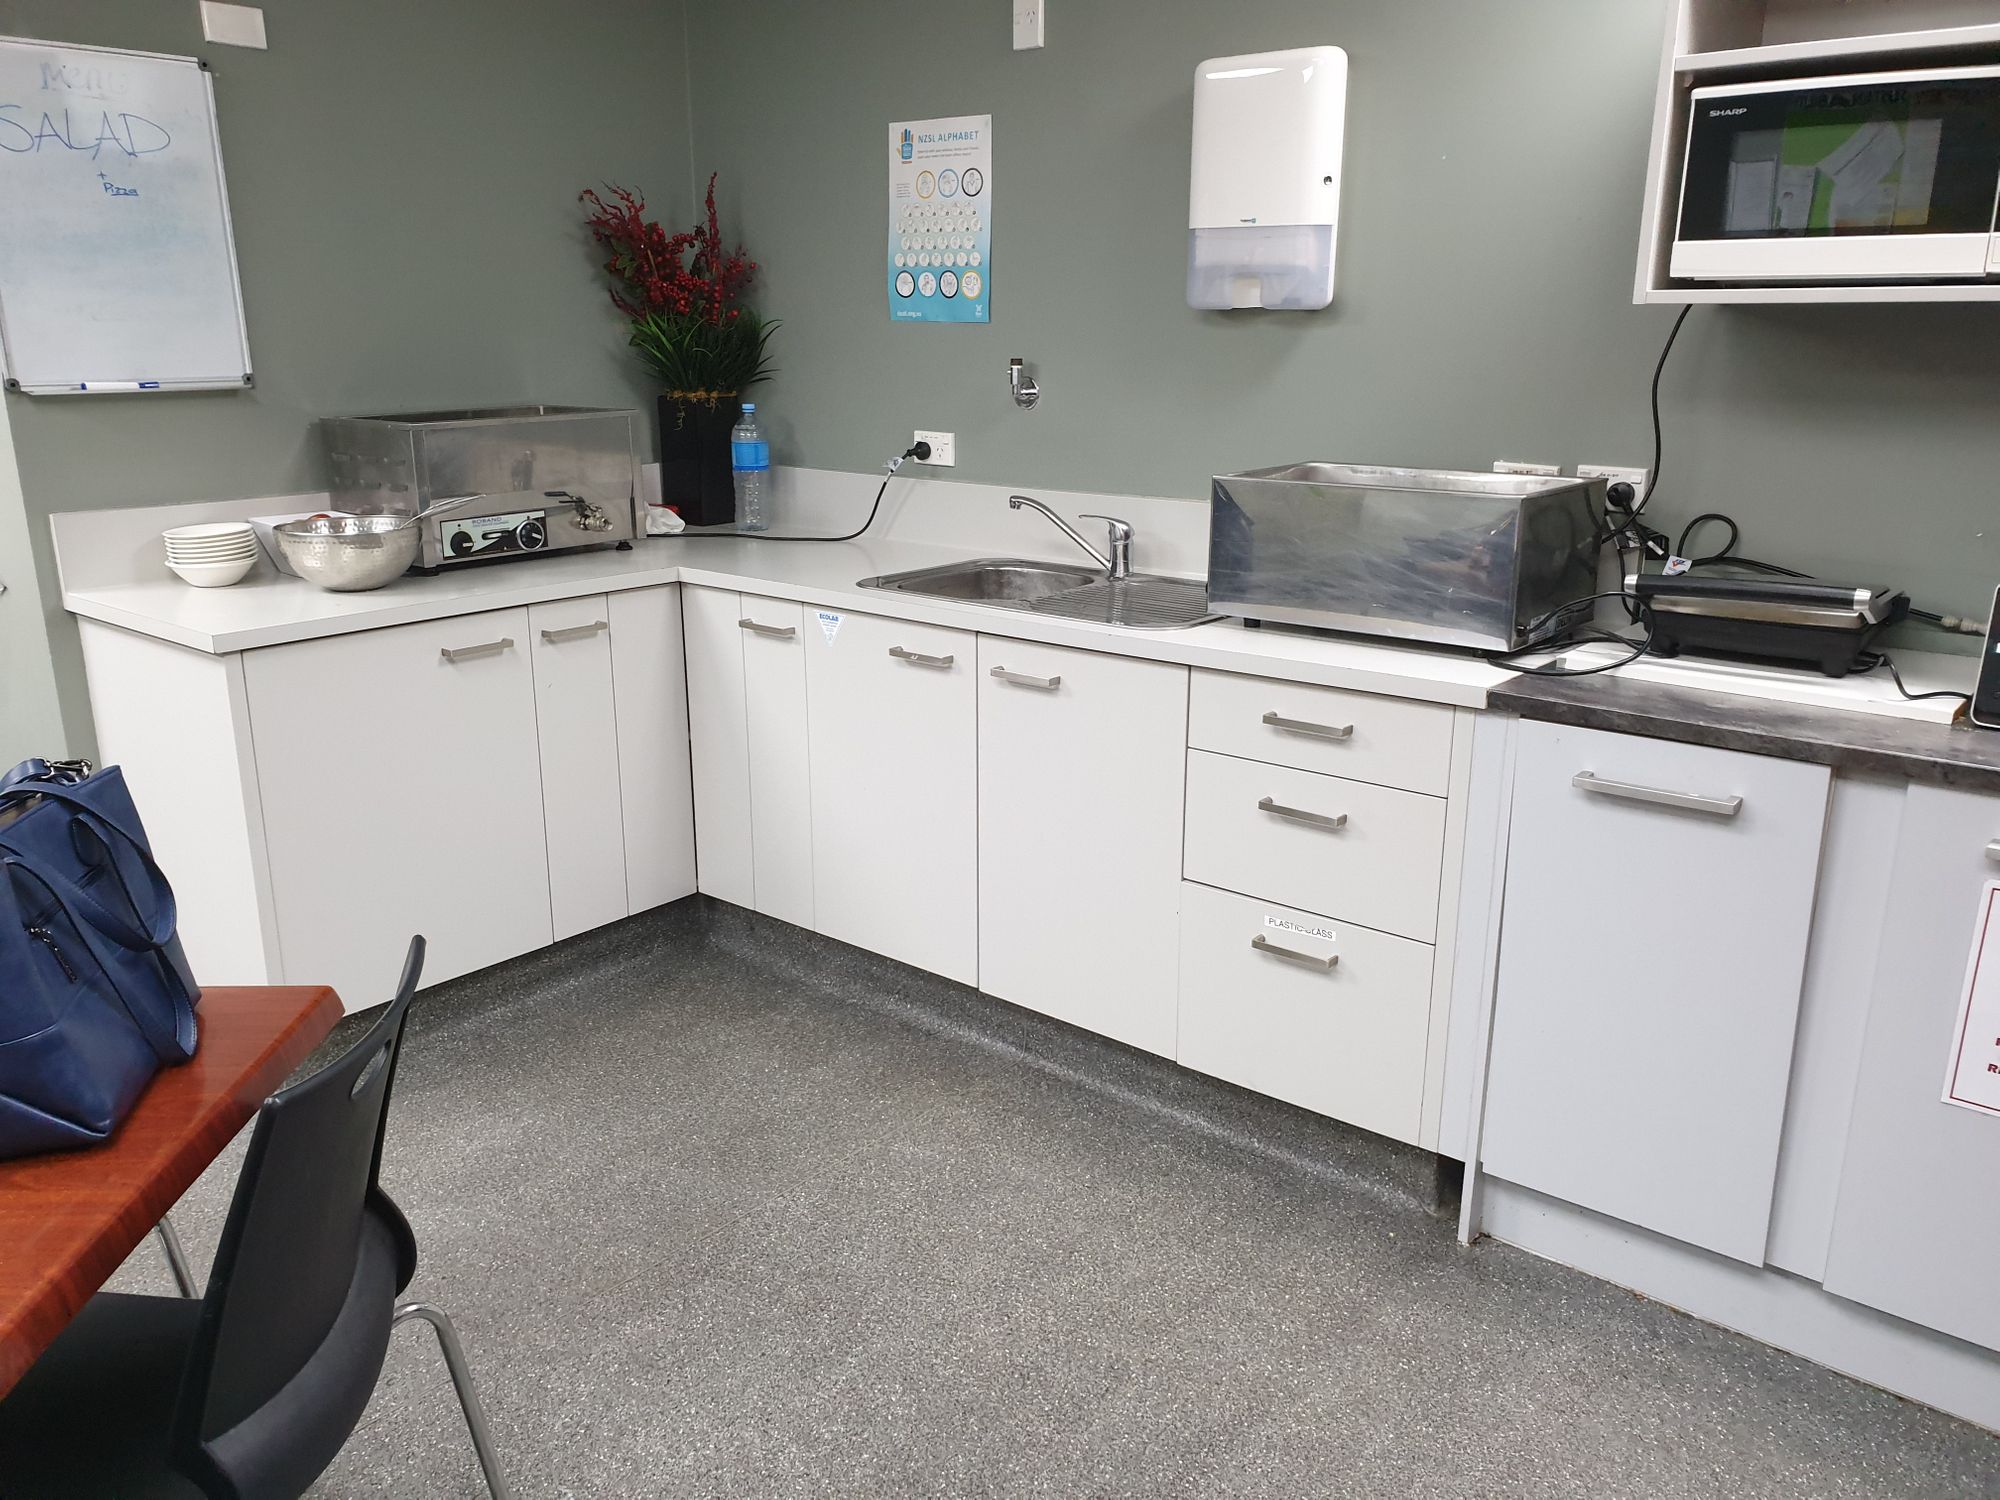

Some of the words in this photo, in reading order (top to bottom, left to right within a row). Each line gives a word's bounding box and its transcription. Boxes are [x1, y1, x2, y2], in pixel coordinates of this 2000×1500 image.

[1710, 107, 1747, 117] SHARP
[0, 104, 171, 160] SALAD
[918, 134, 936, 143] NZSL
[938, 130, 979, 142] ALPHABET
[1268, 917, 1303, 932] PLASTIC
